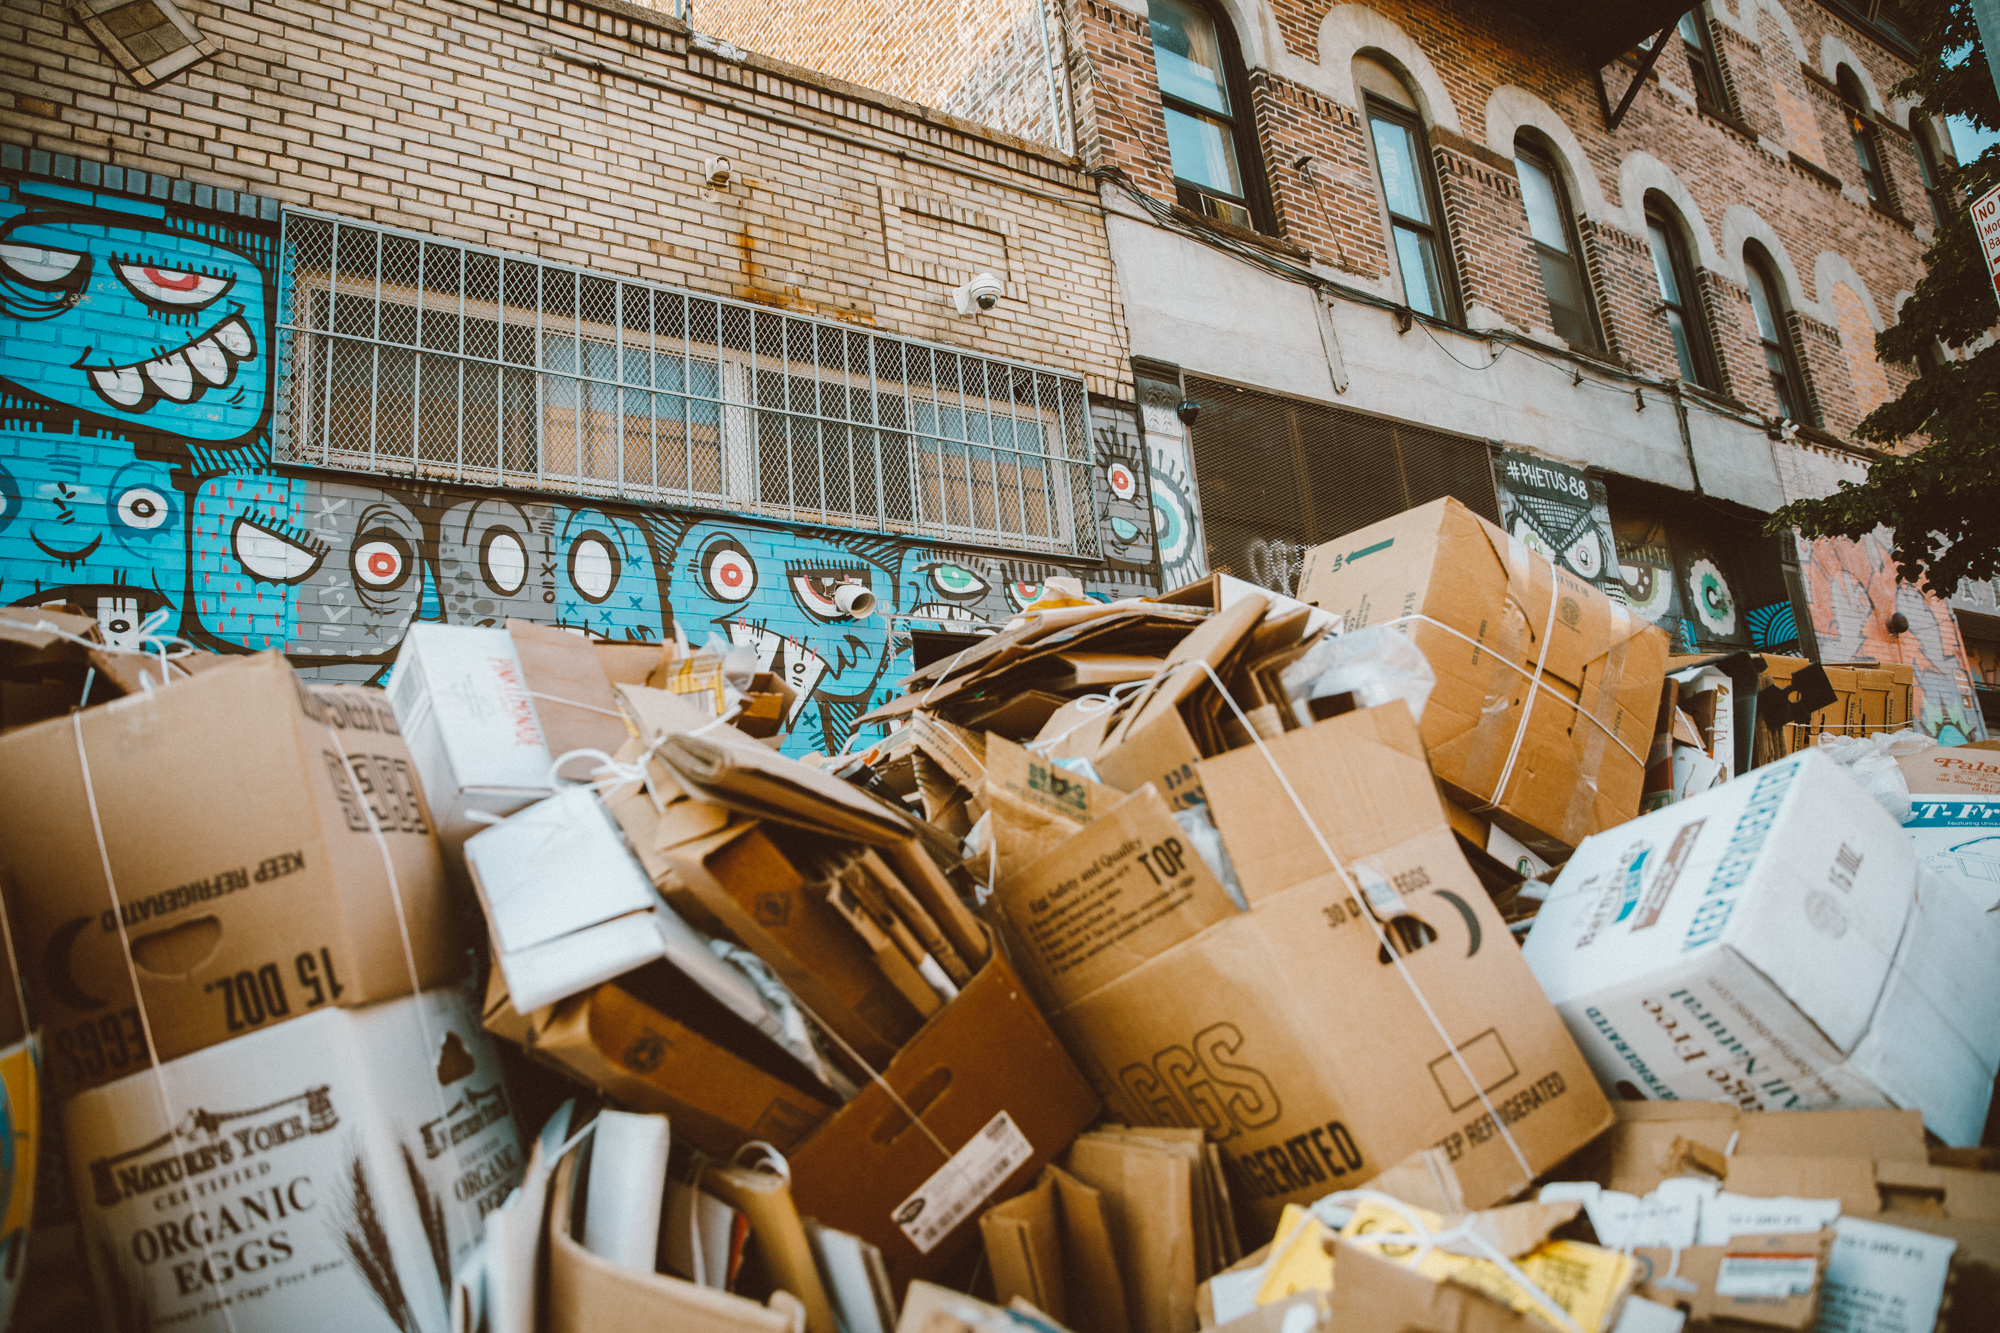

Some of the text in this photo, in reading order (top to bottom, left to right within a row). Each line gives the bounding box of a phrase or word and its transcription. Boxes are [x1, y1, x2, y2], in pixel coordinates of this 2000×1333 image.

[1978, 201, 1996, 221] NO
[1332, 554, 1343, 573] UP
[1933, 758, 2000, 774] Pala
[253, 849, 306, 884] KEEP
[1081, 863, 1101, 882] and
[1136, 836, 1187, 886] TOP
[1681, 897, 1736, 953] KEEP
[203, 946, 346, 1033] 15 DOZ.
[1641, 998, 1765, 1113] age Free
[1669, 988, 1769, 1076] Natural
[1117, 1021, 1283, 1143] GGS
[131, 1175, 317, 1265] ORGANIC
[172, 1230, 294, 1296] EGGS
